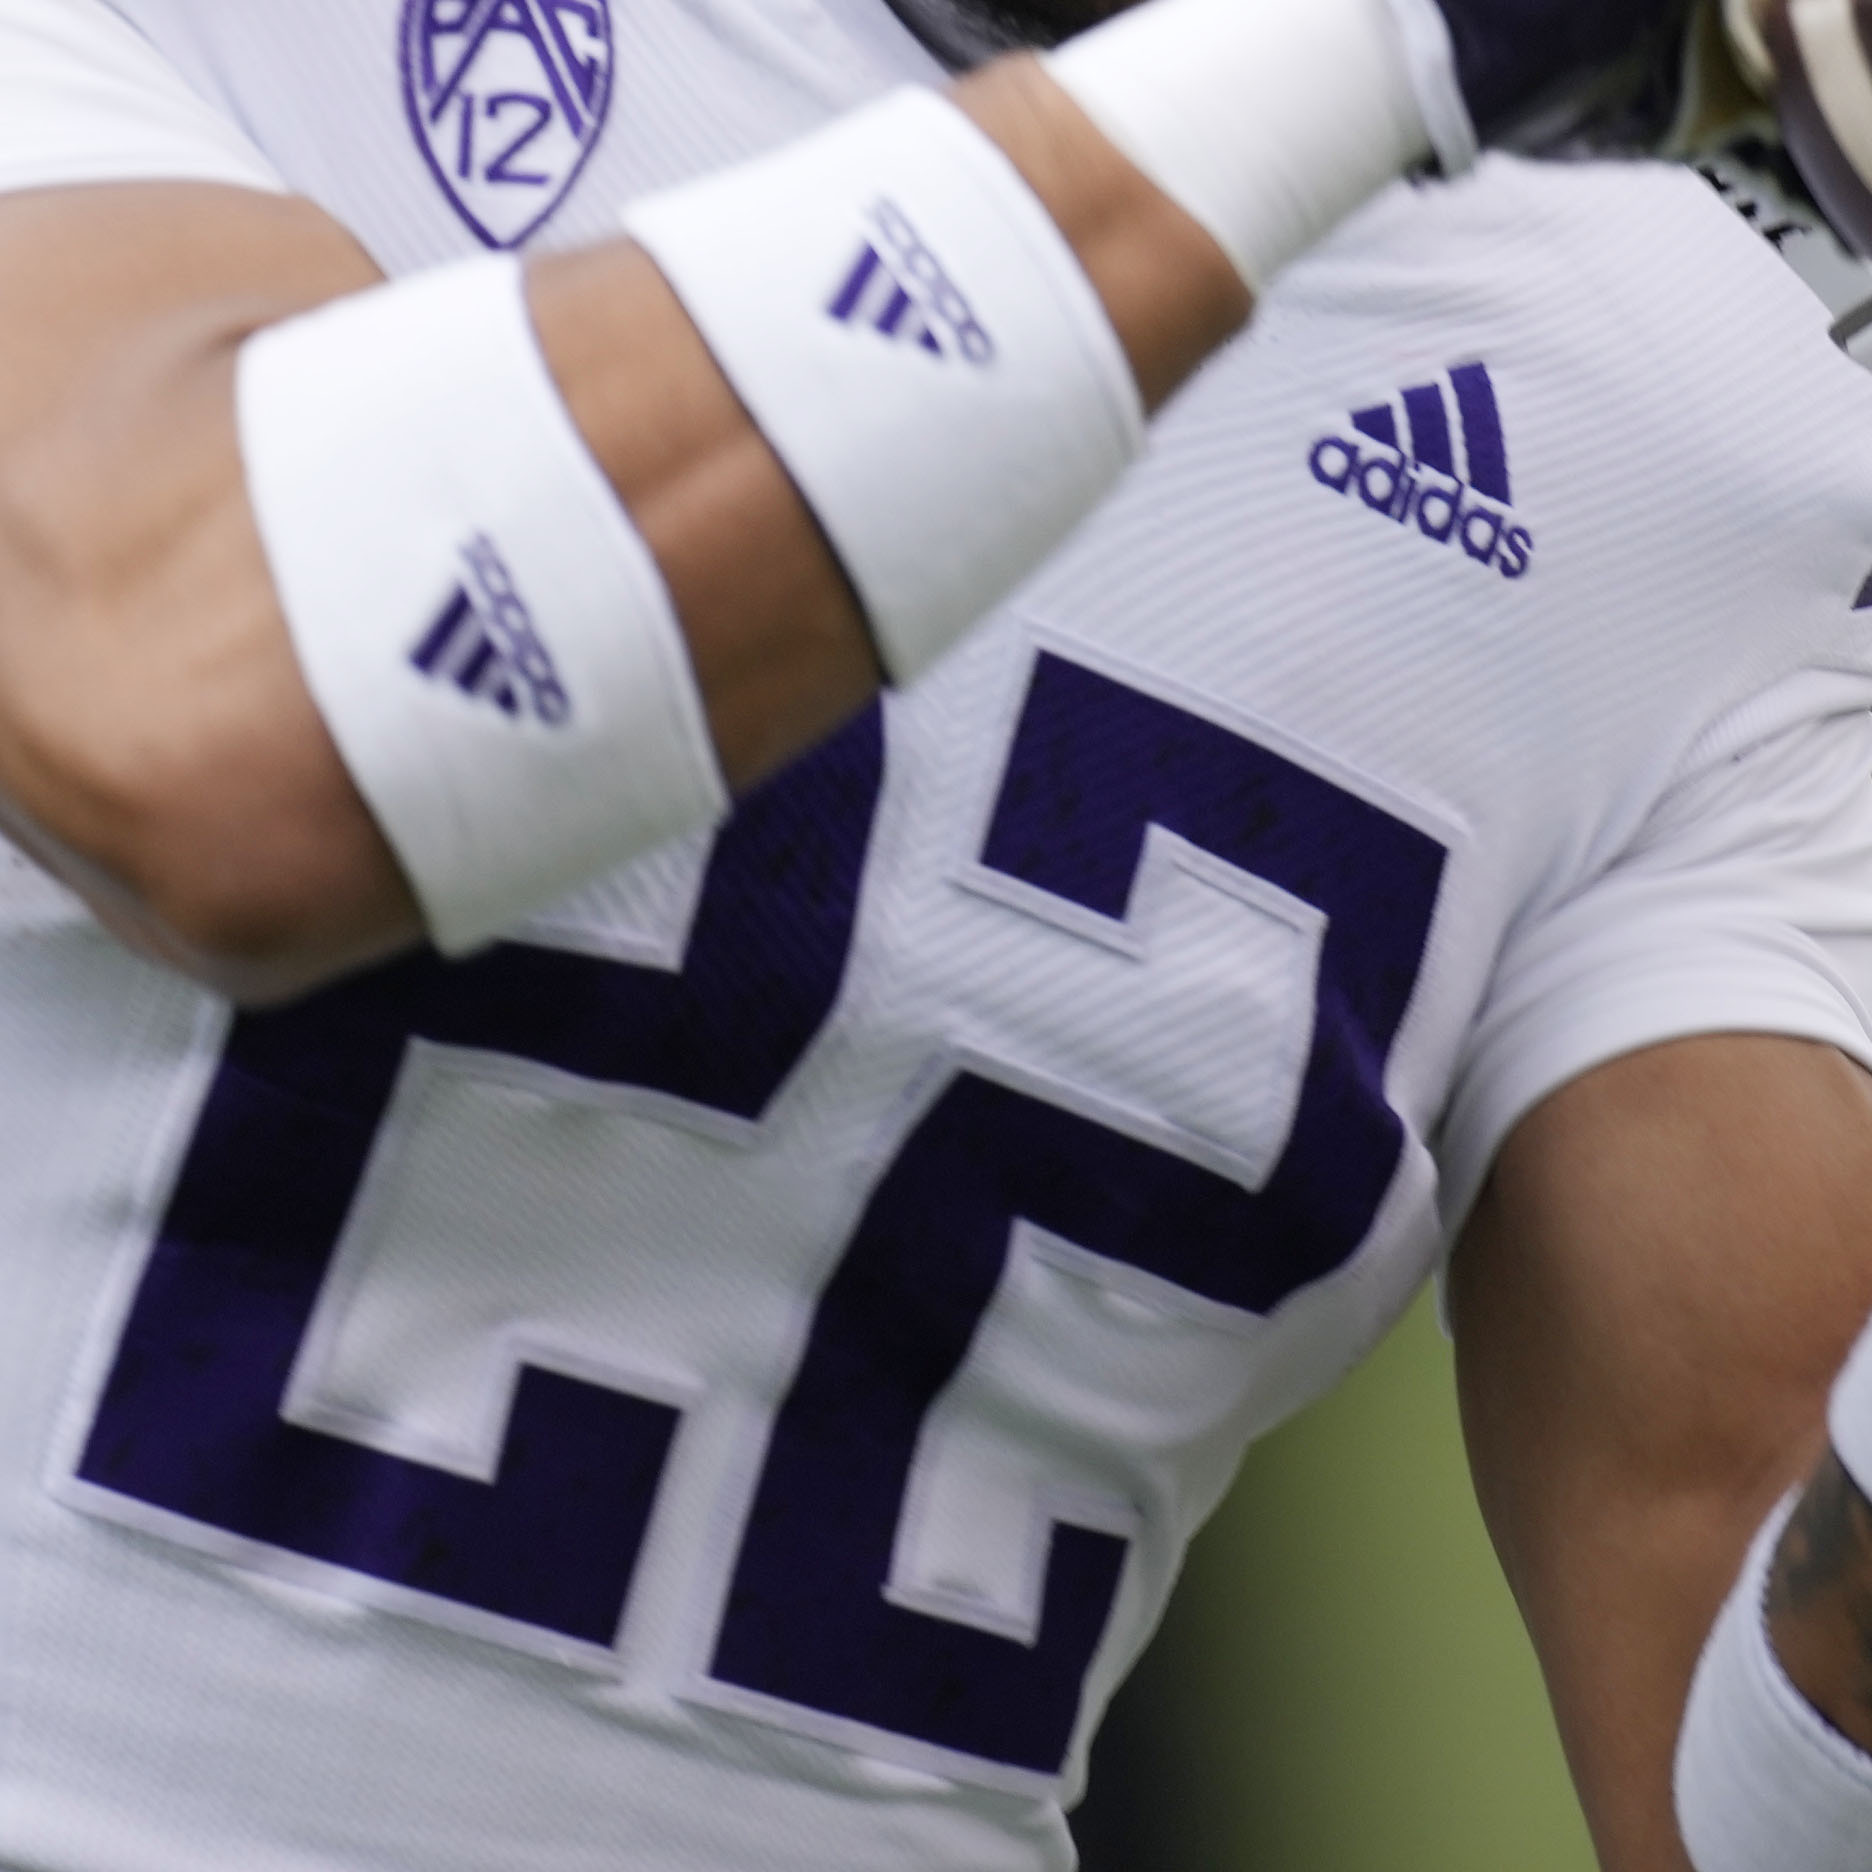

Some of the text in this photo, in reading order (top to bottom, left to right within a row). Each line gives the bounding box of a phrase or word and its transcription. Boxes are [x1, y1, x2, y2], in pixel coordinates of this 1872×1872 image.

[456, 90, 553, 185] 12
[1308, 436, 1534, 579] adidas
[68, 643, 1456, 1783] 22
